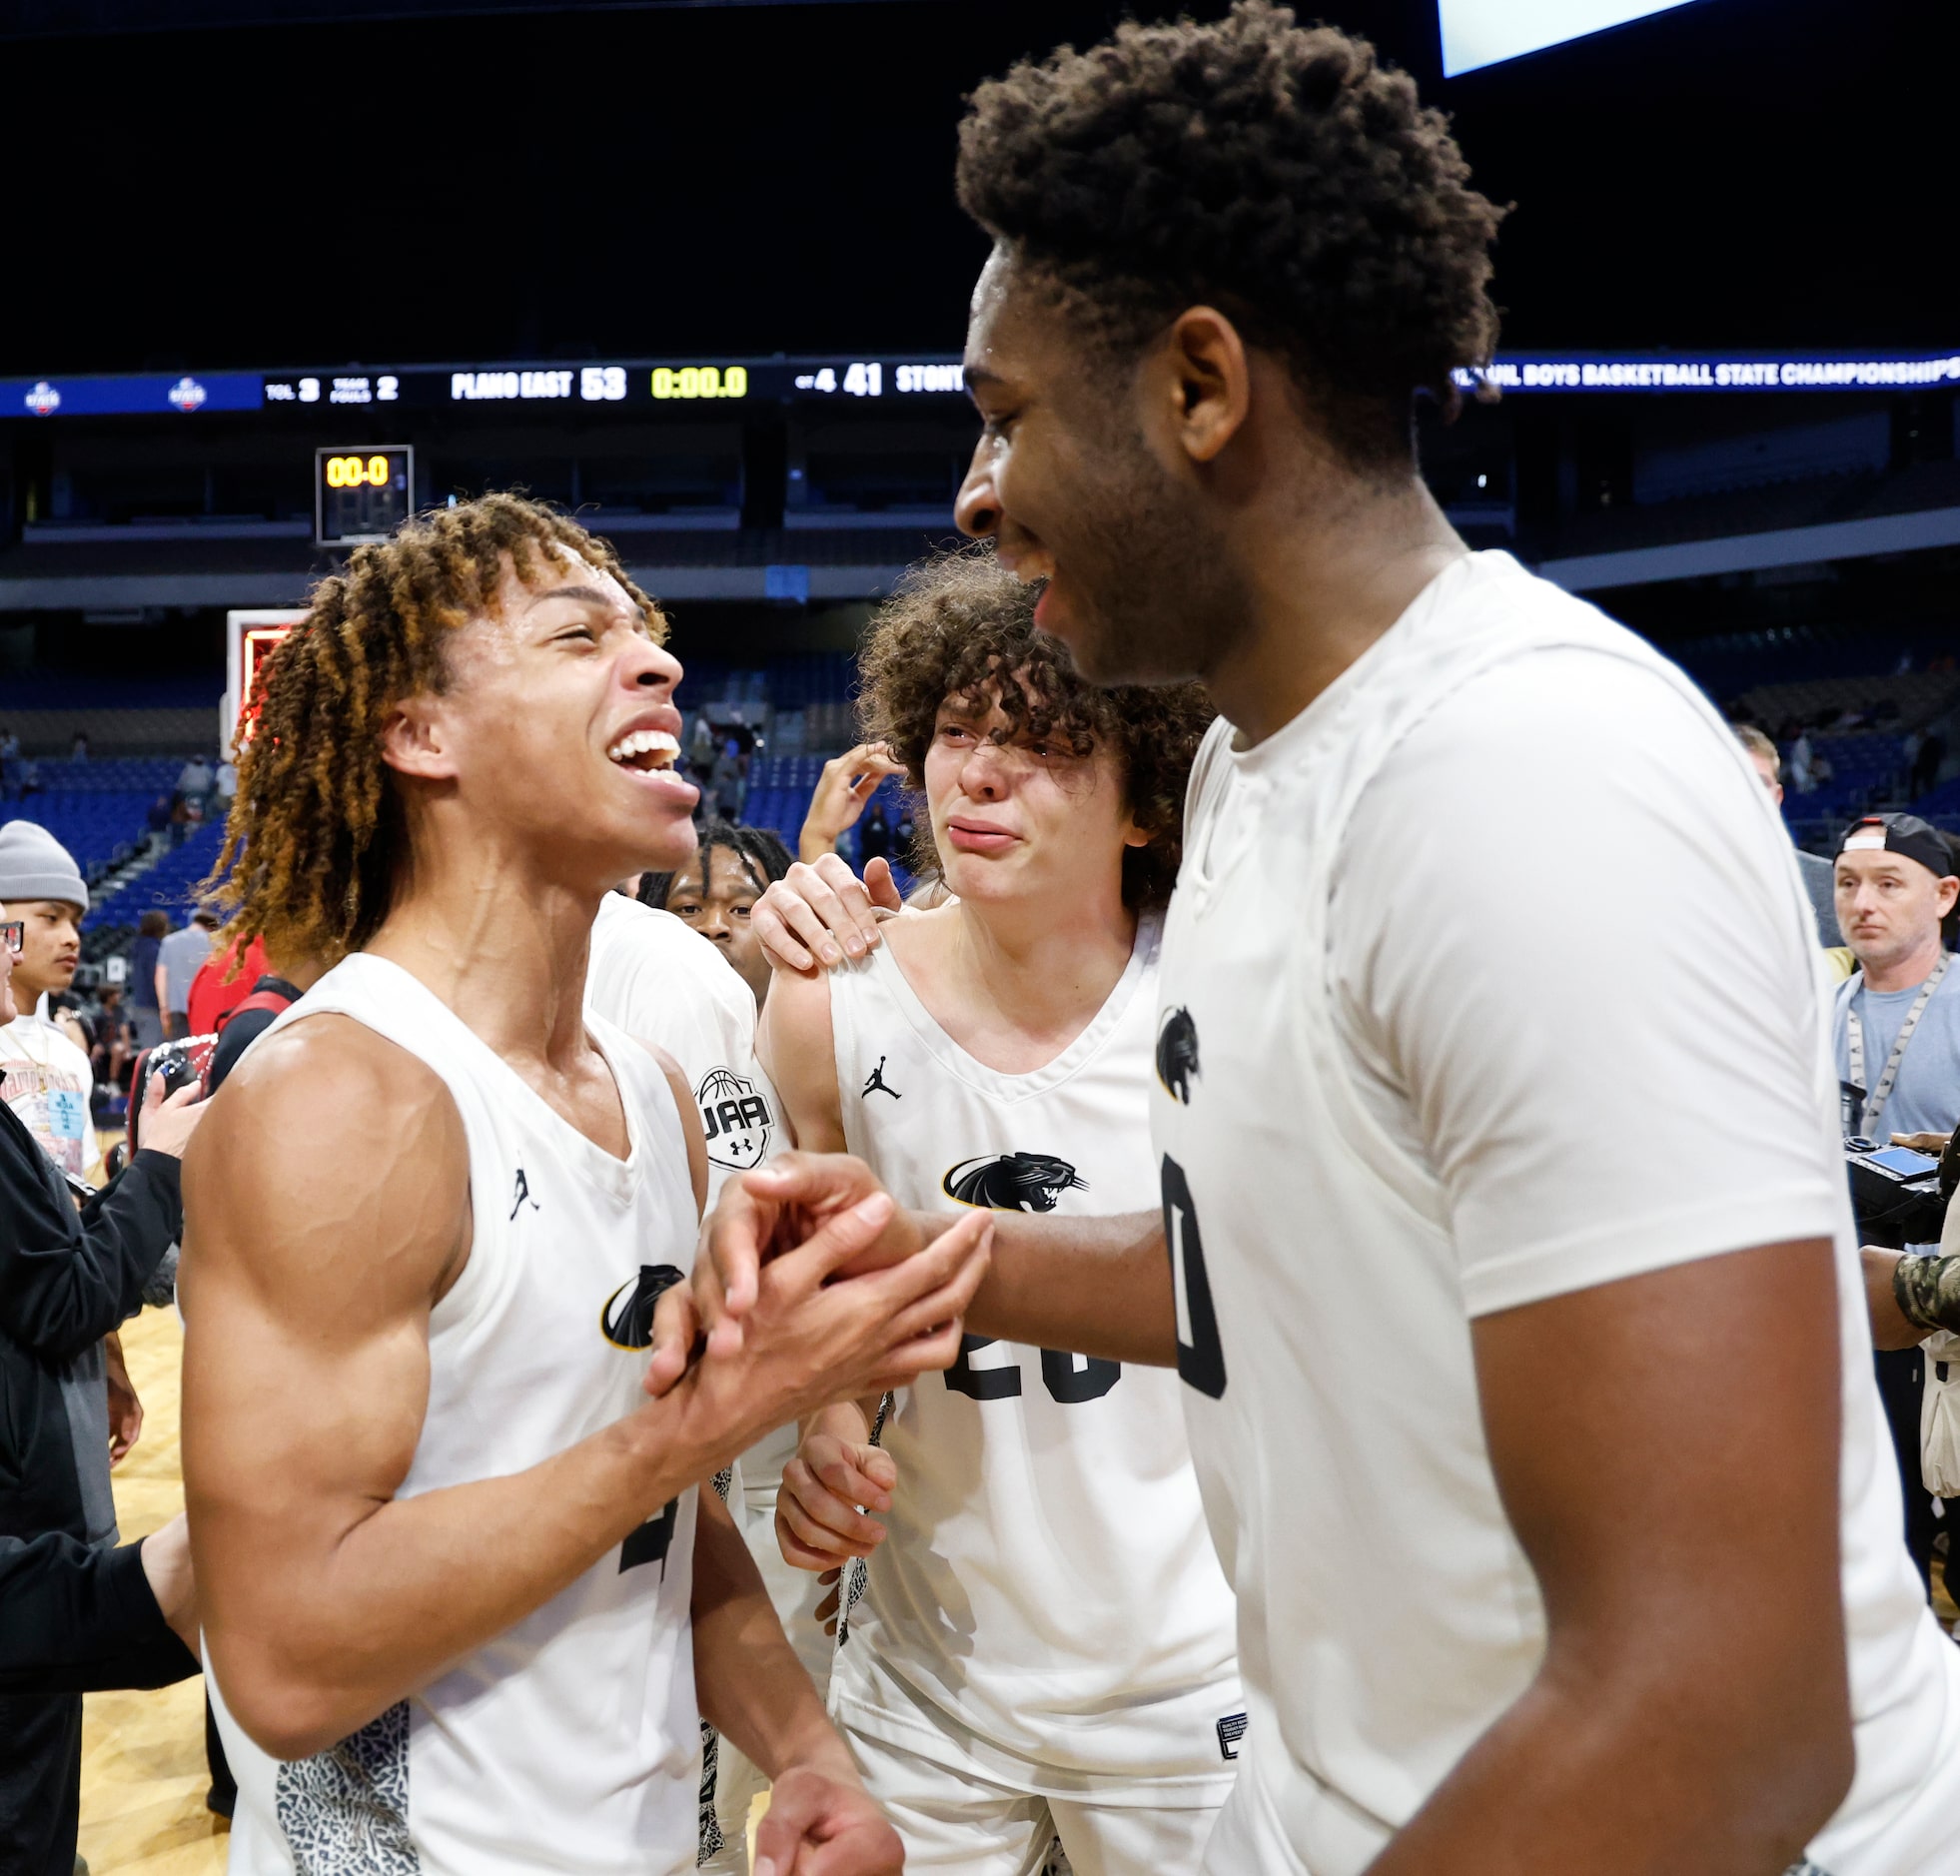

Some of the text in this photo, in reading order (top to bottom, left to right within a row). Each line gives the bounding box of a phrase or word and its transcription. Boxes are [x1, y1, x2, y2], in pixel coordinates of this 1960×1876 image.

[377, 376, 399, 401] 2
[452, 366, 627, 401] PLANO EAST 53
[651, 366, 747, 399] 0:00.0
[813, 368, 837, 393] 4
[842, 363, 882, 397] 41
[1522, 364, 1580, 387] BOYS
[1581, 364, 1714, 387] BASKETBALL
[1714, 363, 1780, 387] STATE
[299, 378, 321, 403] 3
